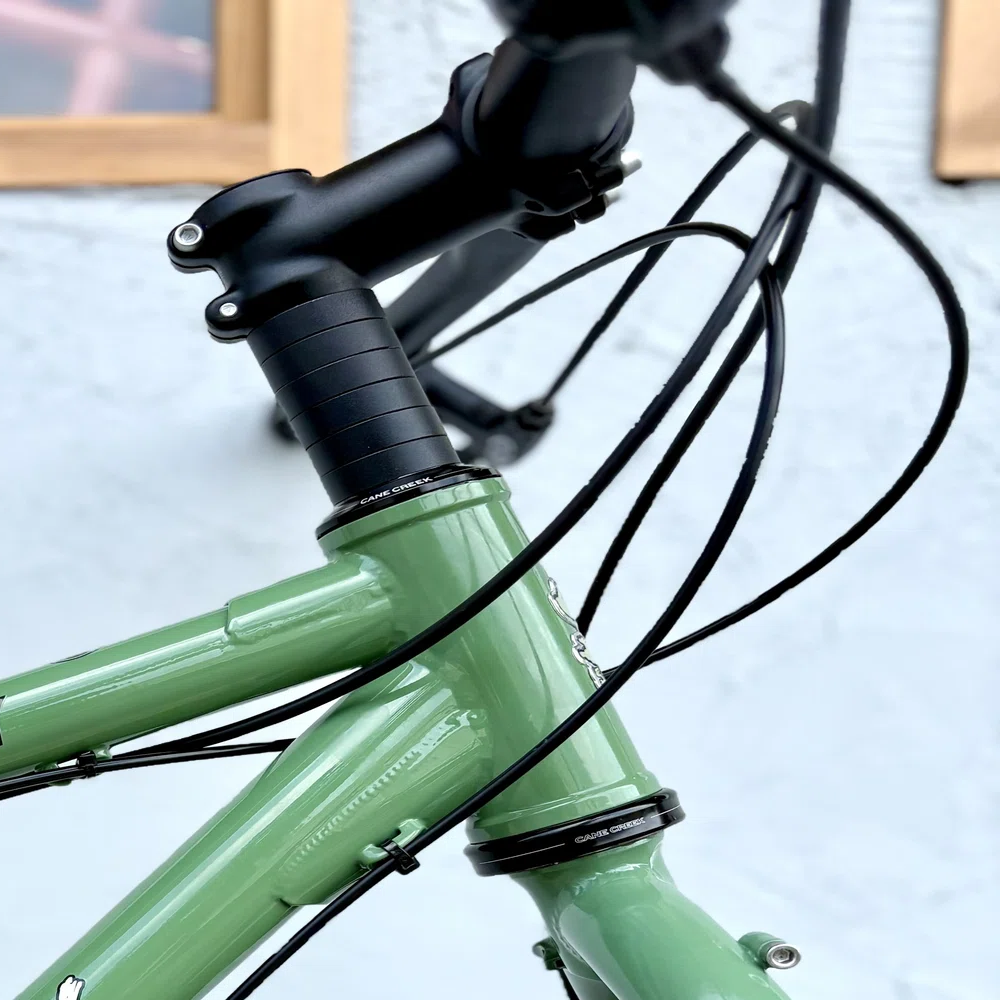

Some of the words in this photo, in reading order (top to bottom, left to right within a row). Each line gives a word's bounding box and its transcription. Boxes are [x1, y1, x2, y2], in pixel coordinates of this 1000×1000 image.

[360, 489, 391, 505] CANE
[391, 476, 434, 493] CREEK
[574, 828, 609, 844] CANE
[609, 816, 646, 834] CREEK
